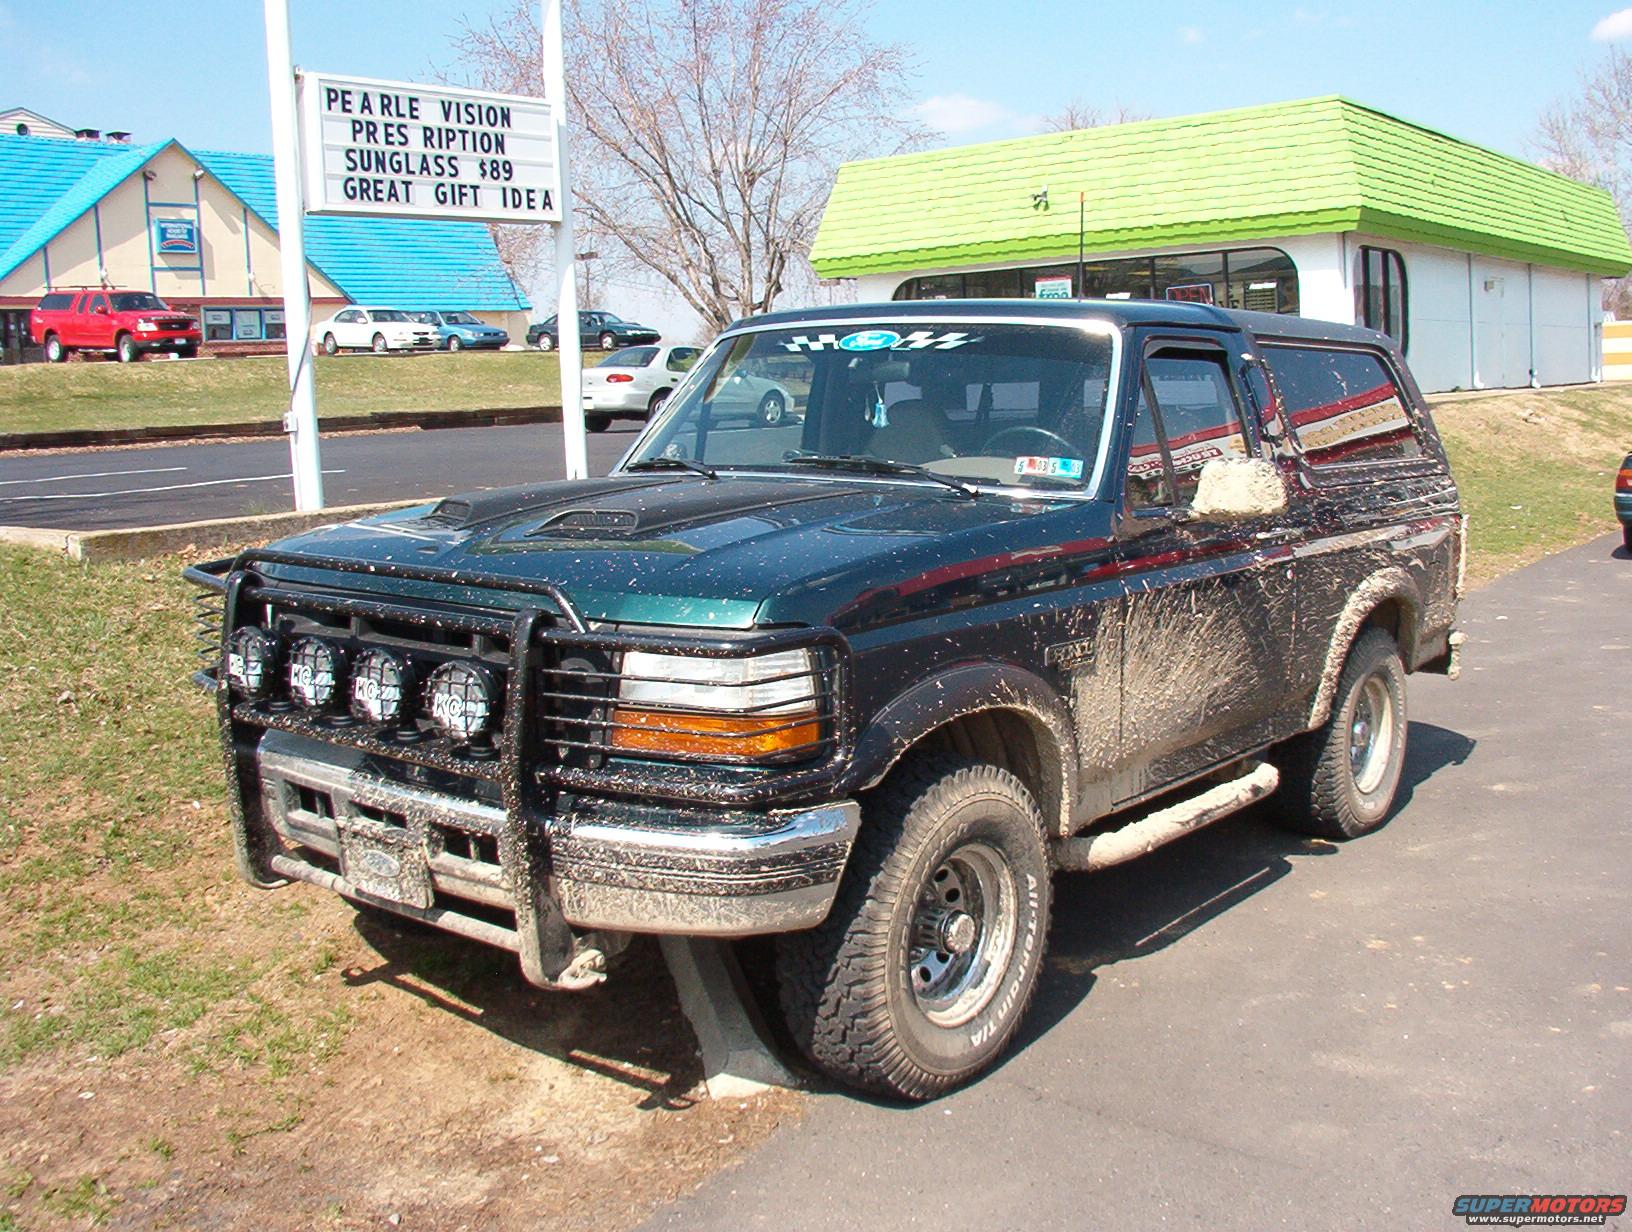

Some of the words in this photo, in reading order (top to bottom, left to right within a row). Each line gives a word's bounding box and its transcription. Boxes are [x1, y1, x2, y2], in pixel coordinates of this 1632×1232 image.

[326, 88, 420, 120] PEARLE
[441, 100, 511, 128] VISION
[345, 149, 459, 178] SUNGLASS
[479, 158, 513, 181] $89
[343, 177, 413, 203] GREAT
[435, 183, 480, 206] GIFT
[502, 187, 553, 210] IDEA
[432, 693, 463, 718] KC
